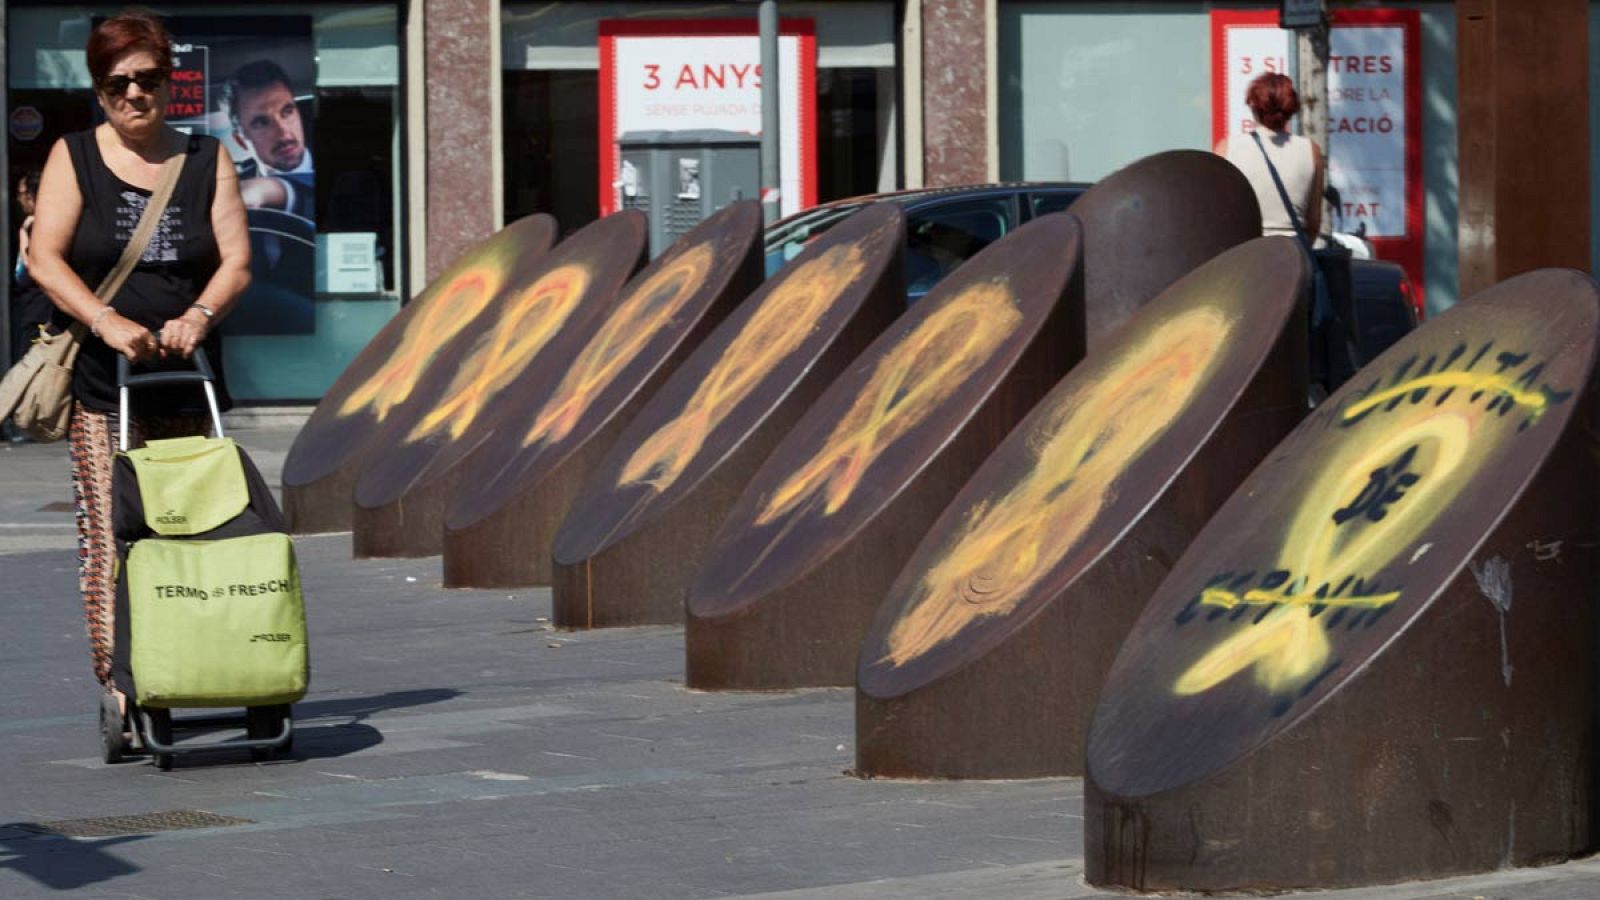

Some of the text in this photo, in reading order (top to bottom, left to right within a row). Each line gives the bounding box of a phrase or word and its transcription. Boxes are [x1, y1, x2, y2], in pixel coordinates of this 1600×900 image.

[1240, 55, 1252, 74] 3
[642, 64, 661, 90] 3
[155, 584, 209, 601] TERMO
